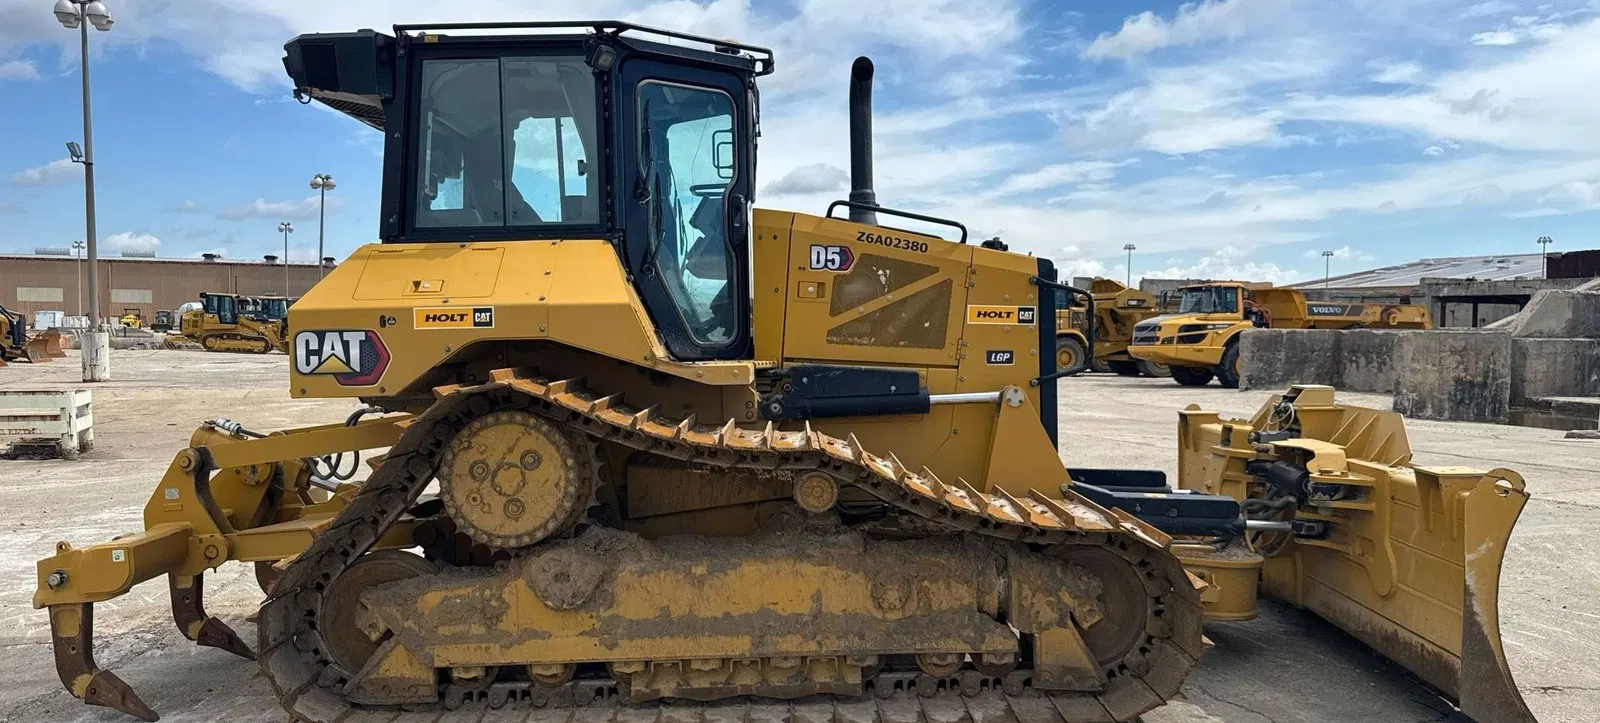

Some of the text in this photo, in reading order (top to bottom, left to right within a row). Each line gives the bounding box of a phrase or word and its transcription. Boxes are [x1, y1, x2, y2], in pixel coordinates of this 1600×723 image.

[857, 231, 928, 253] Z6A02380
[811, 245, 840, 269] D5
[425, 312, 490, 322] HOLT CAT
[1020, 311, 1033, 320] CAT
[296, 331, 365, 373] CAT
[991, 353, 1010, 362] LGP
